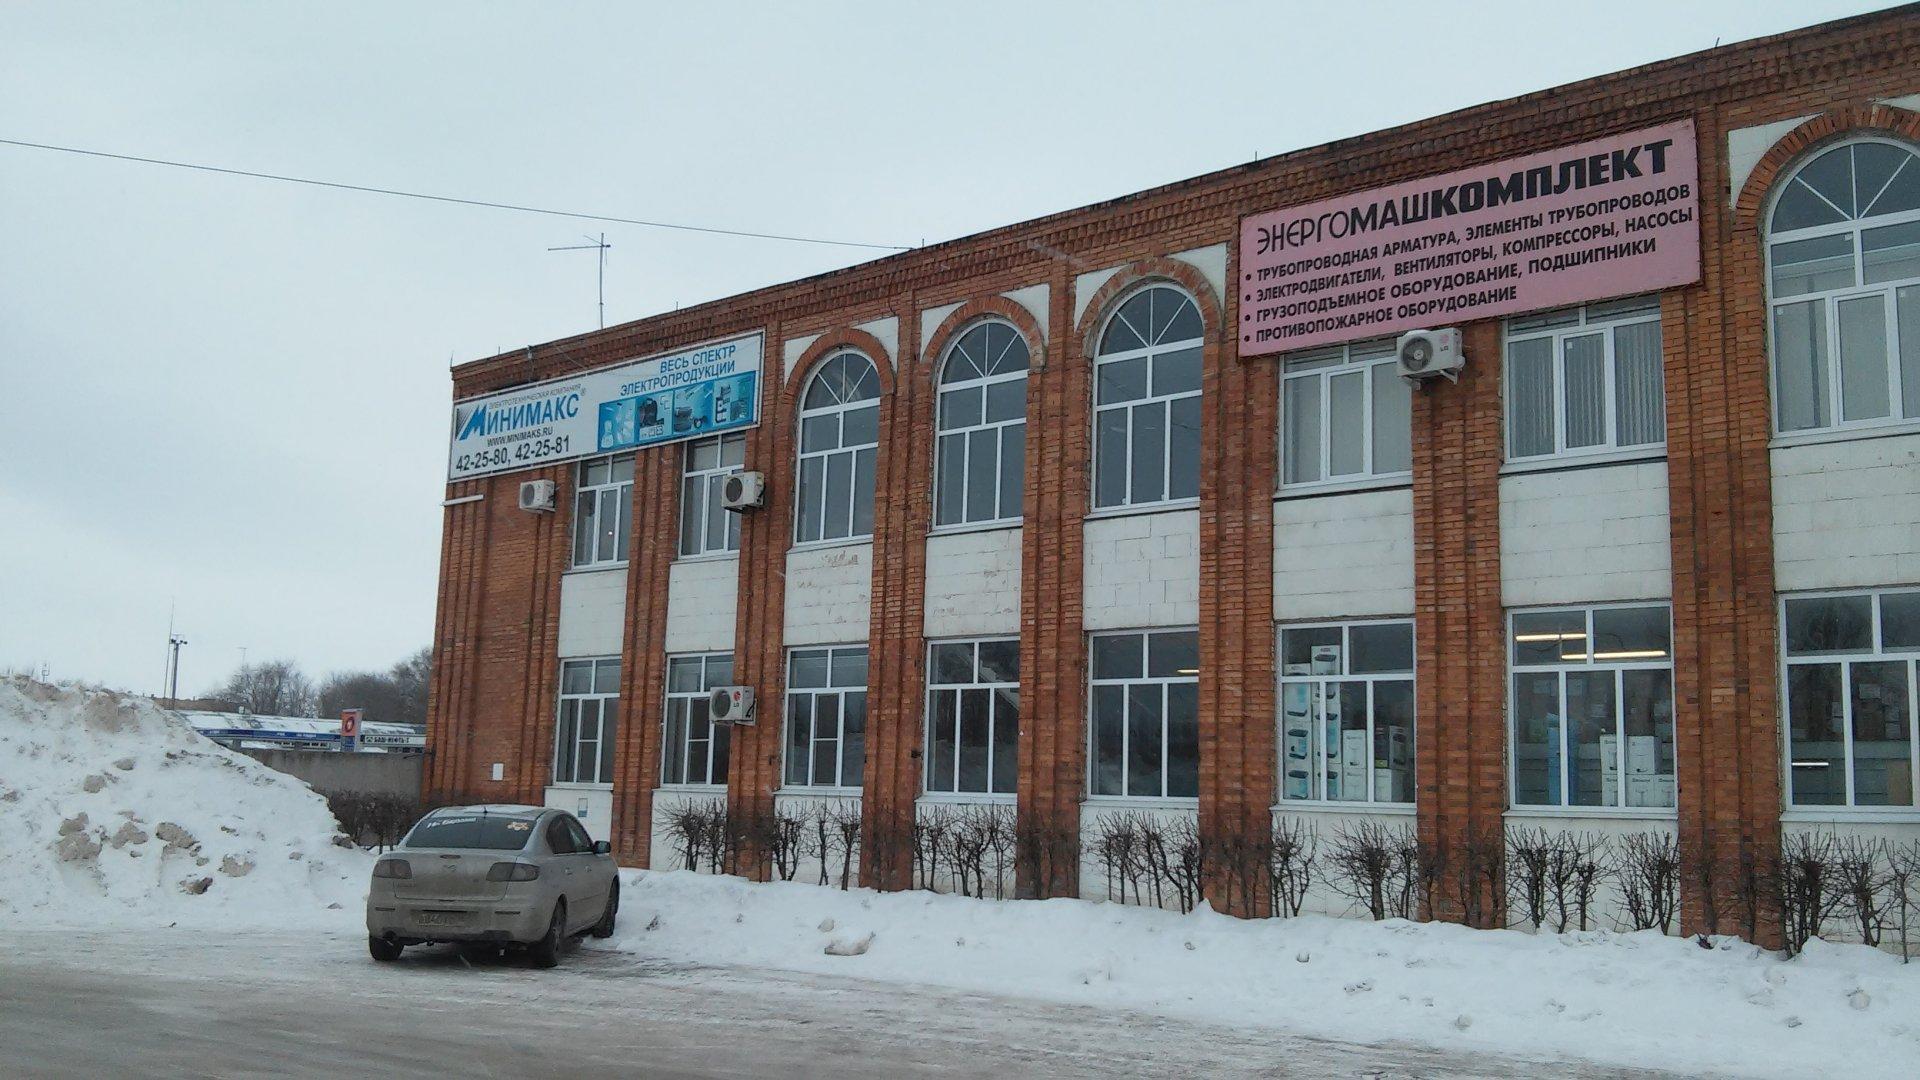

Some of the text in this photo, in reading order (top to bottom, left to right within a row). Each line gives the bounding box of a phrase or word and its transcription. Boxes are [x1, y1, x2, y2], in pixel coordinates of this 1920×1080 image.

[1257, 138, 1673, 255] ЭНЕРГОМАШКОМПЛЕКТ
[1256, 207, 1693, 302] ЭЛЕКТРОДВИГАТЕЛИ, ВЕНТИЛЯТОРЫ, КОМПРЕССОРЫ, НАСОСЫ
[1257, 184, 1690, 281] ТРУБОПРОВОДНАЯ АРМАТУРА, ЭЛЕМЕНТЫ ТРУБОПРОВОДОВ
[1256, 238, 1656, 322] ГРУЗОПОДЪЕМНОЕ ОБОРУДОВАНИЕ, ПОДШИПНИКИ
[1256, 286, 1517, 342] ПРОТИВОПОЖАРНОЕ ОБОРУДОВАНИЕ
[620, 360, 735, 396] ЭЛЕКТРОПРОДУКЦИИ
[660, 345, 736, 373] ВЕСЬ СПЕКТР
[459, 393, 579, 440] МИНИМАКС
[487, 426, 553, 447] WWW.MINIMAKS.RU
[456, 435, 569, 472] 42-25-80, 42-25-81
